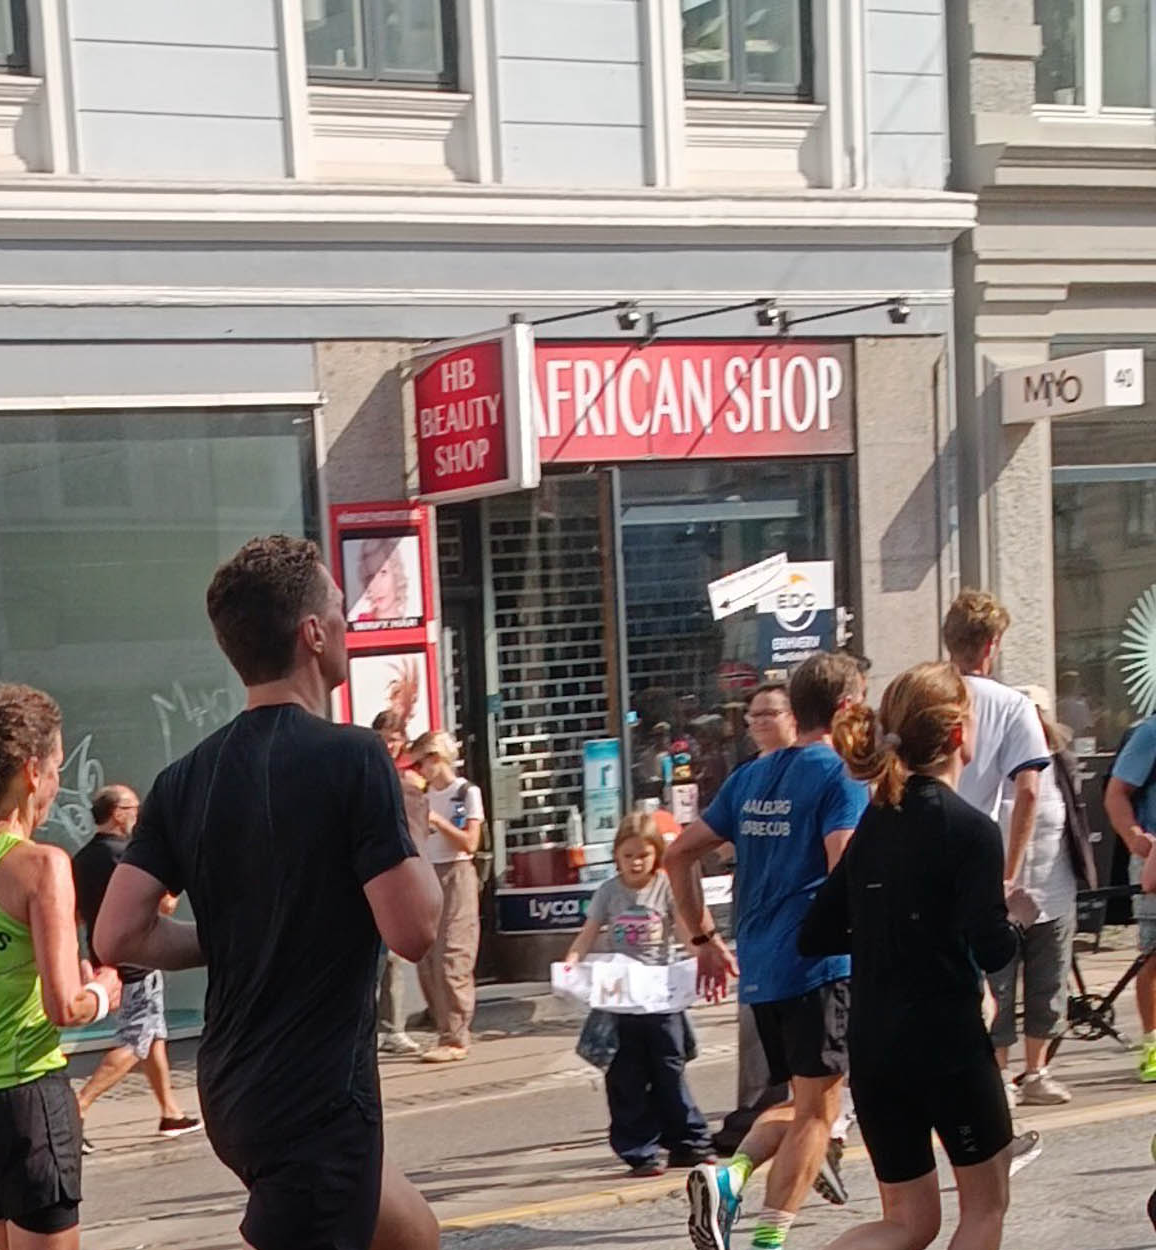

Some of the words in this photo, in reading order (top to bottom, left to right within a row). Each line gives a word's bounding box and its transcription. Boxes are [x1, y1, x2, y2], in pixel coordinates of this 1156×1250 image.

[440, 358, 477, 393] HB
[724, 354, 842, 433] SHOP
[419, 393, 501, 439] BEAUTY
[434, 438, 490, 477] SHOP
[777, 592, 816, 609] EDC
[529, 898, 580, 920] Lyca
